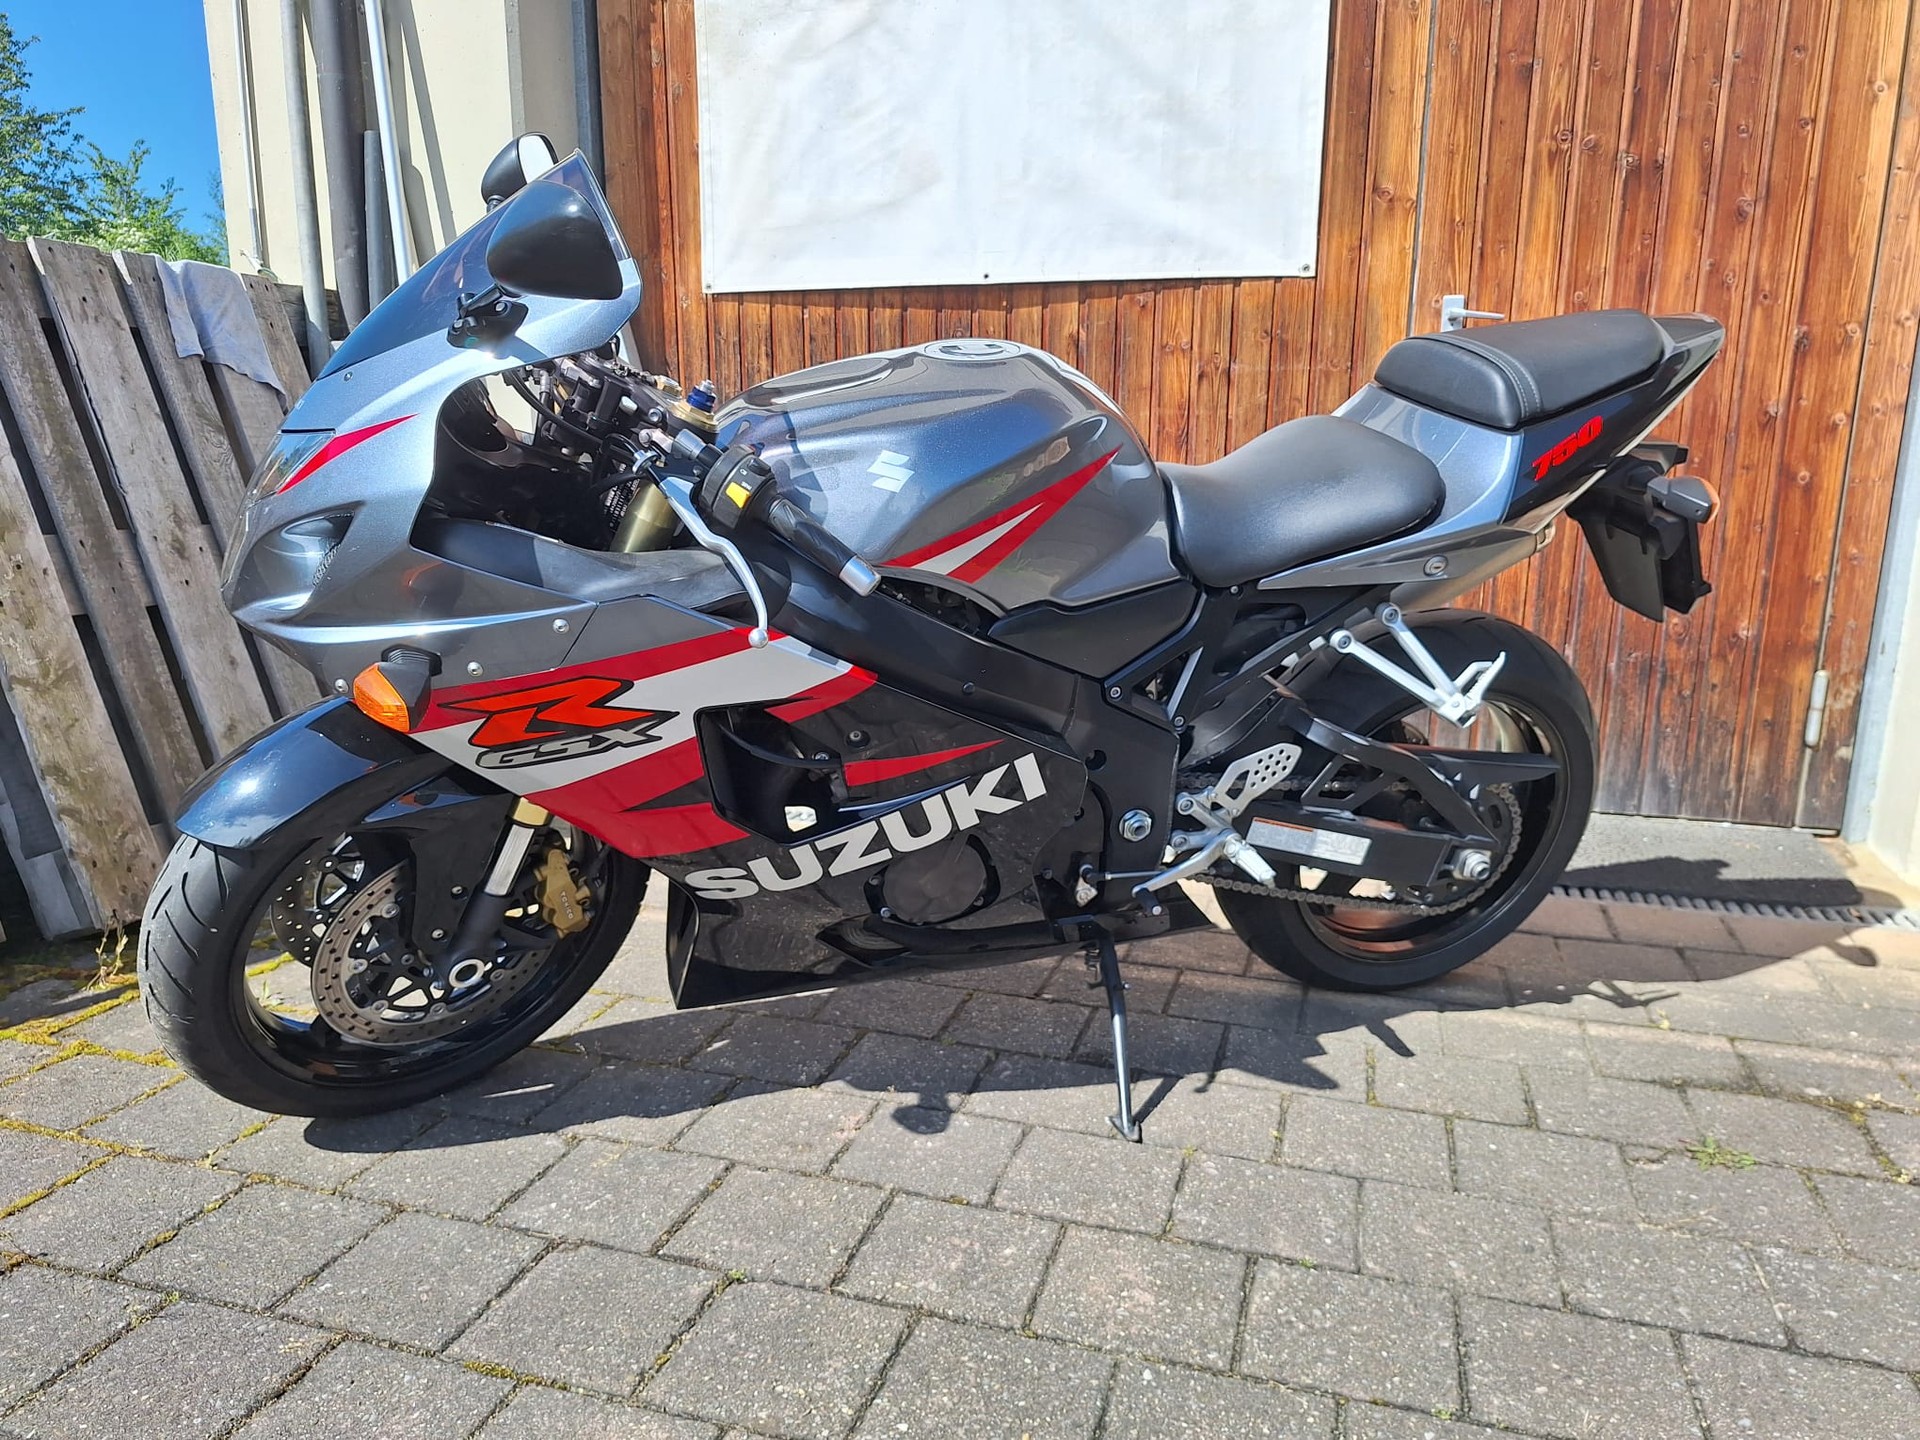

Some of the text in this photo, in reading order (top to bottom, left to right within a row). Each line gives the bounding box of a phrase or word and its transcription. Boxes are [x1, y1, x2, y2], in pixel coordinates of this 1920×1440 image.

[1531, 415, 1604, 481] 750
[446, 677, 660, 748] R
[478, 719, 660, 768] GSX
[684, 752, 1047, 900] SUZUKI
